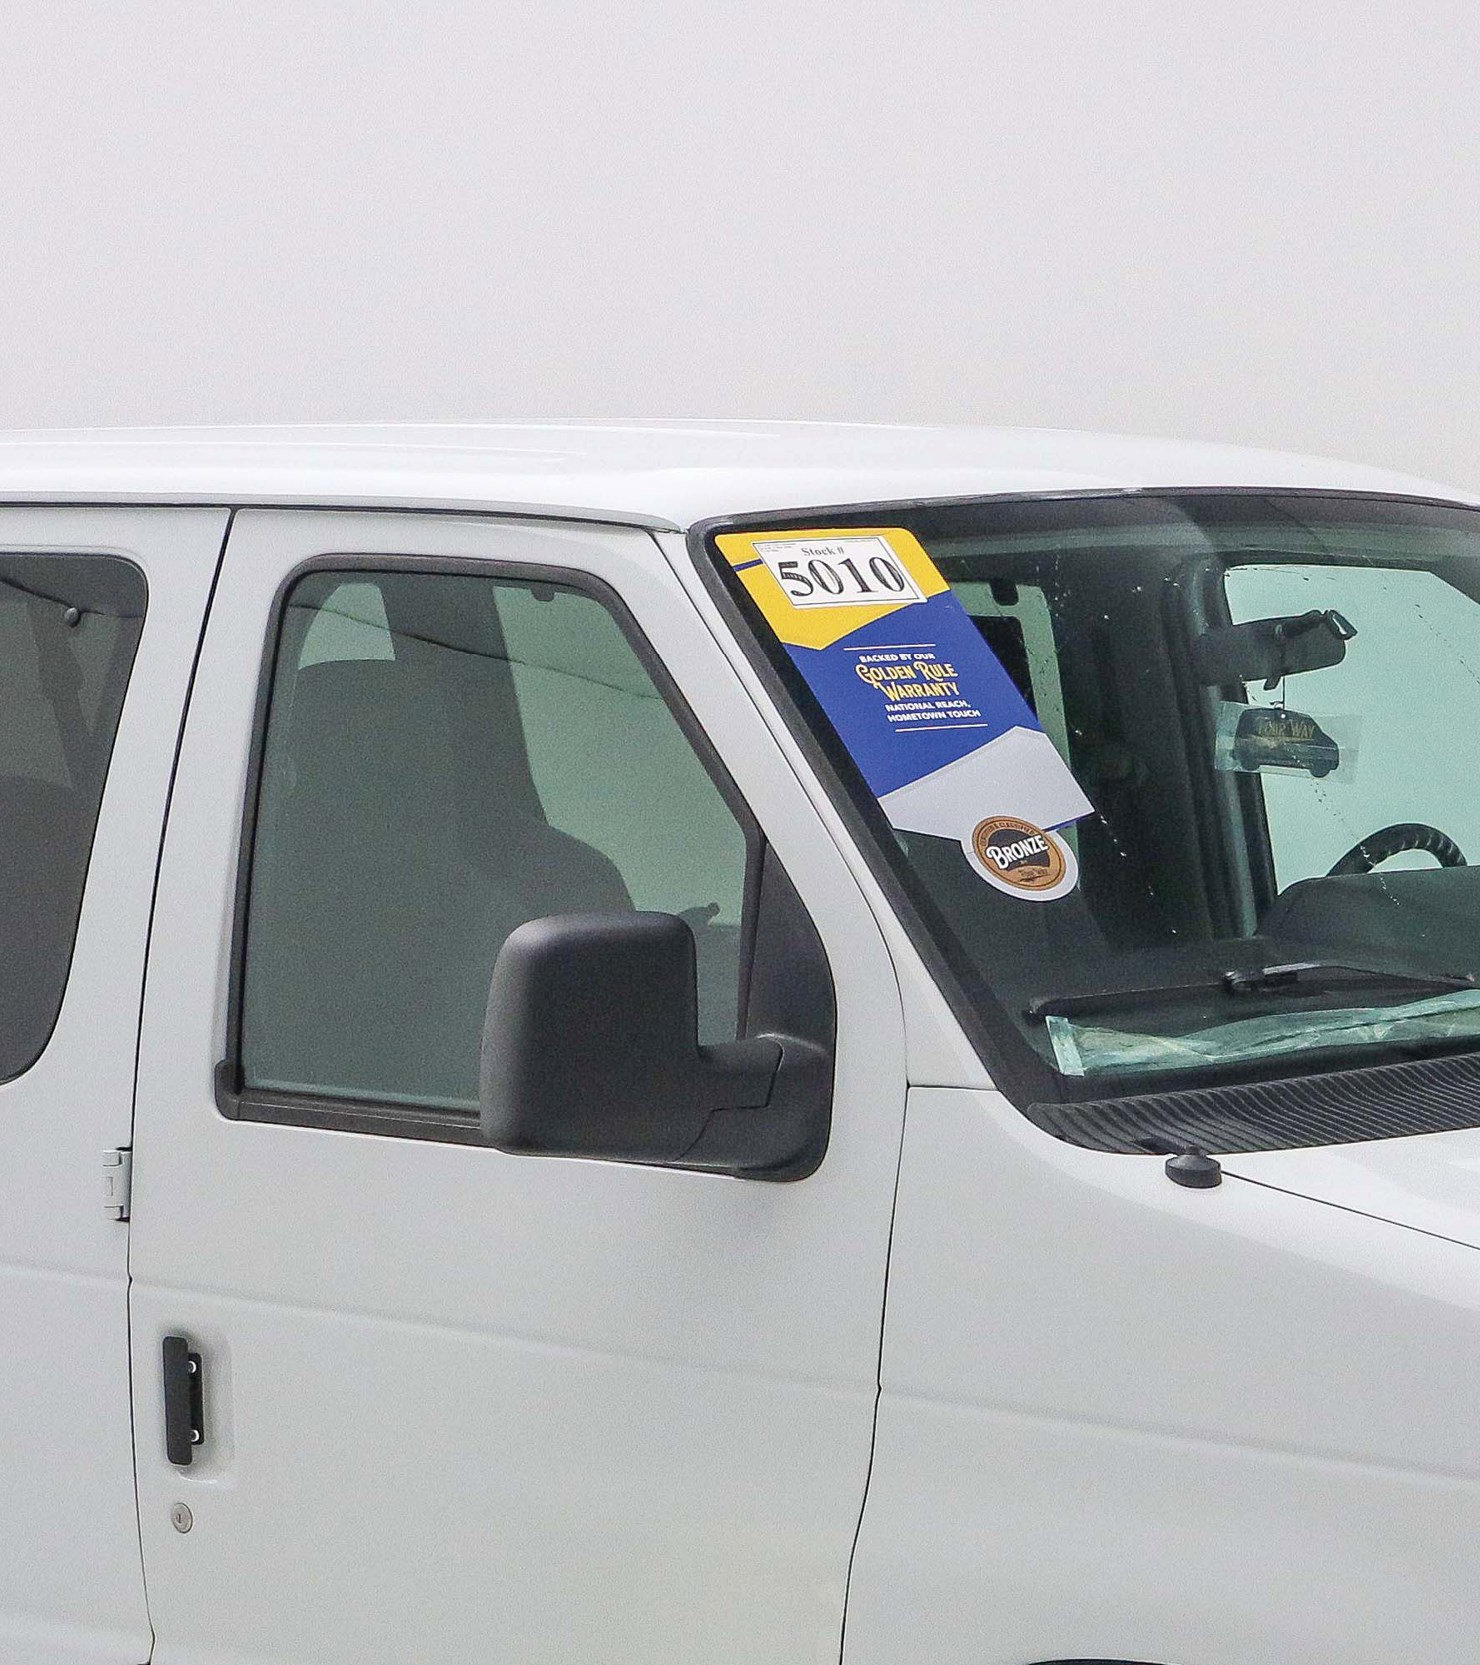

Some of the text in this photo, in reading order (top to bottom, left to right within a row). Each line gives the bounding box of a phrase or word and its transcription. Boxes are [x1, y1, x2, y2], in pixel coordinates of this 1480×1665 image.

[801, 547, 835, 556] Stock
[778, 557, 905, 597] 5010
[859, 654, 898, 663] BACKED
[855, 661, 958, 685] GOLDEN RULE
[873, 682, 960, 701] WARRANTY
[885, 700, 971, 712] NATIONAL REACH,
[887, 710, 981, 722] HOMETOWN TOUCH
[986, 835, 1049, 870] BRONZE
